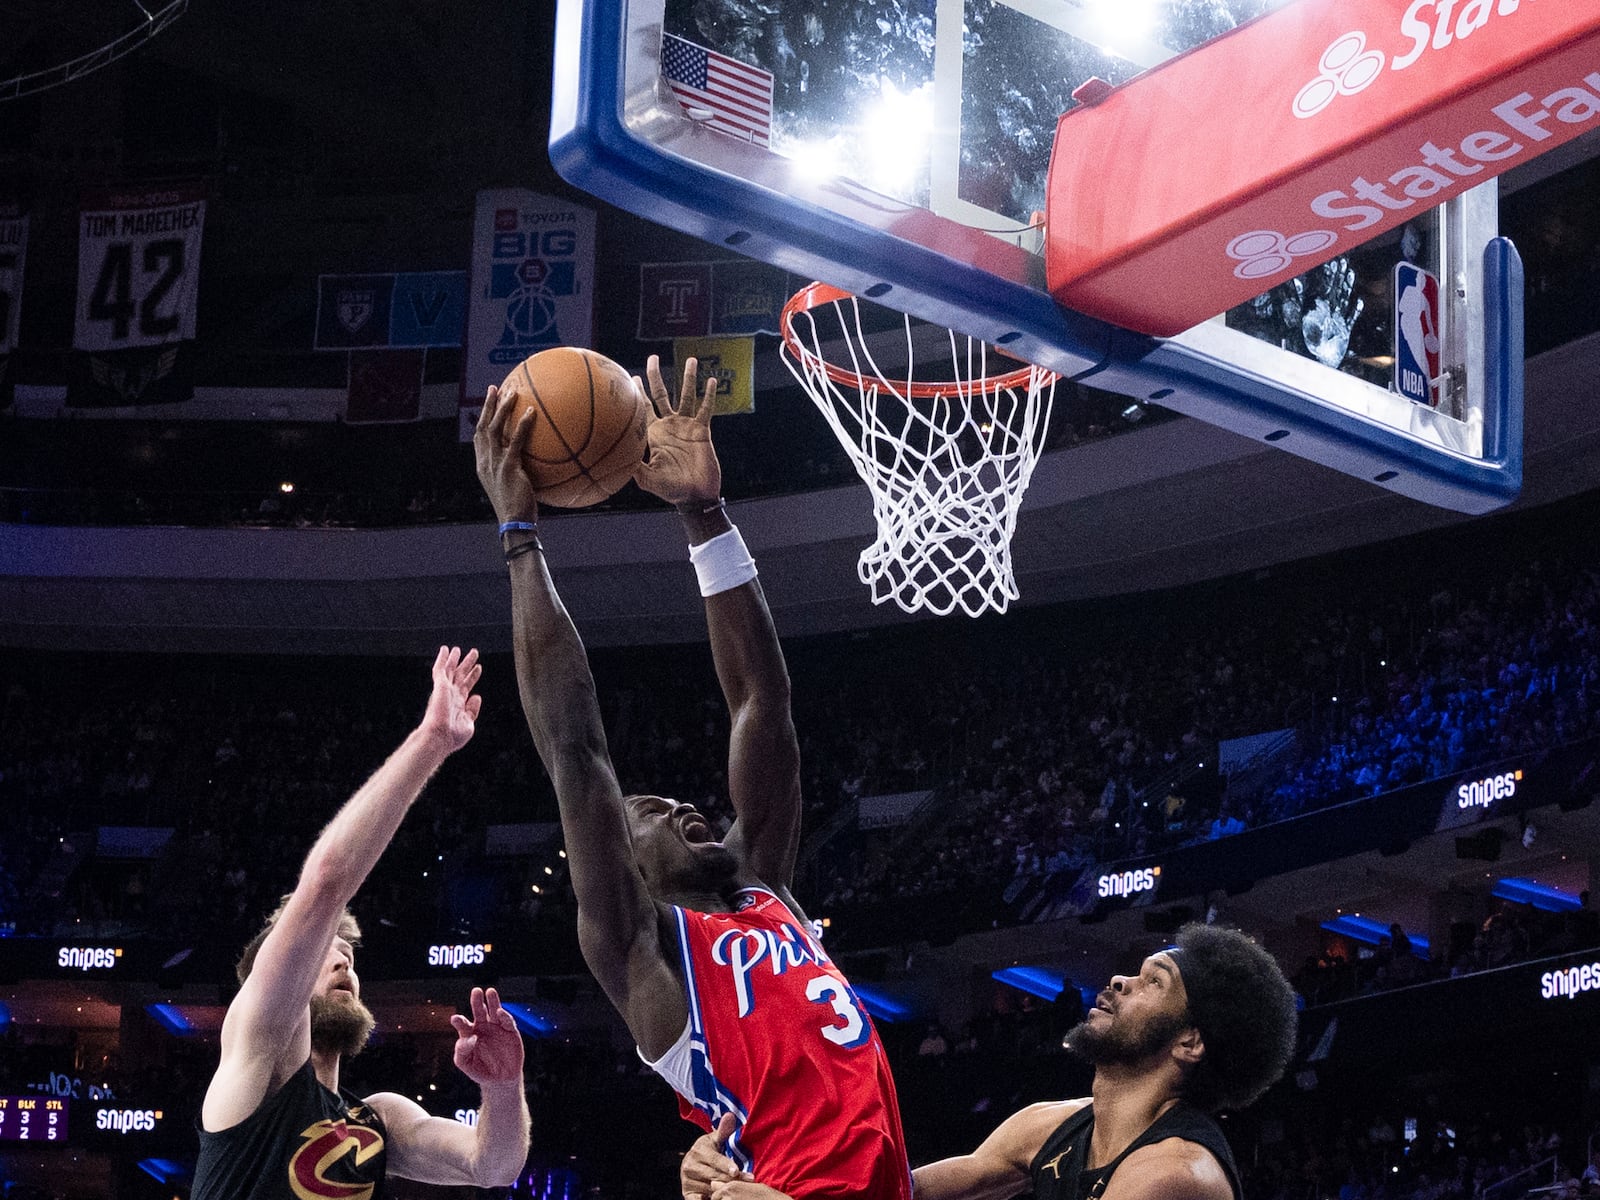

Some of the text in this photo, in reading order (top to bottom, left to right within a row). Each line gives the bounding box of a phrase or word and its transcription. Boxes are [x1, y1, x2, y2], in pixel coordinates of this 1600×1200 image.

[1391, 0, 1537, 71] Sta
[85, 214, 116, 237] TOM
[521, 212, 577, 225] TOYOTA
[493, 229, 577, 258] BIG
[88, 240, 184, 340] 42
[658, 279, 699, 324] T
[1402, 368, 1425, 398] NBA
[1458, 772, 1516, 809] snipes
[1098, 867, 1154, 898] snipes
[58, 947, 115, 971] snipes
[428, 944, 485, 969] snipes
[1541, 962, 1600, 1000] snipes
[805, 974, 872, 1050] 3
[18, 1100, 36, 1110] BLK
[46, 1101, 63, 1110] STL
[20, 1111, 58, 1125] 3 5
[19, 1127, 57, 1140] 2 5
[96, 1109, 156, 1134] snipes
